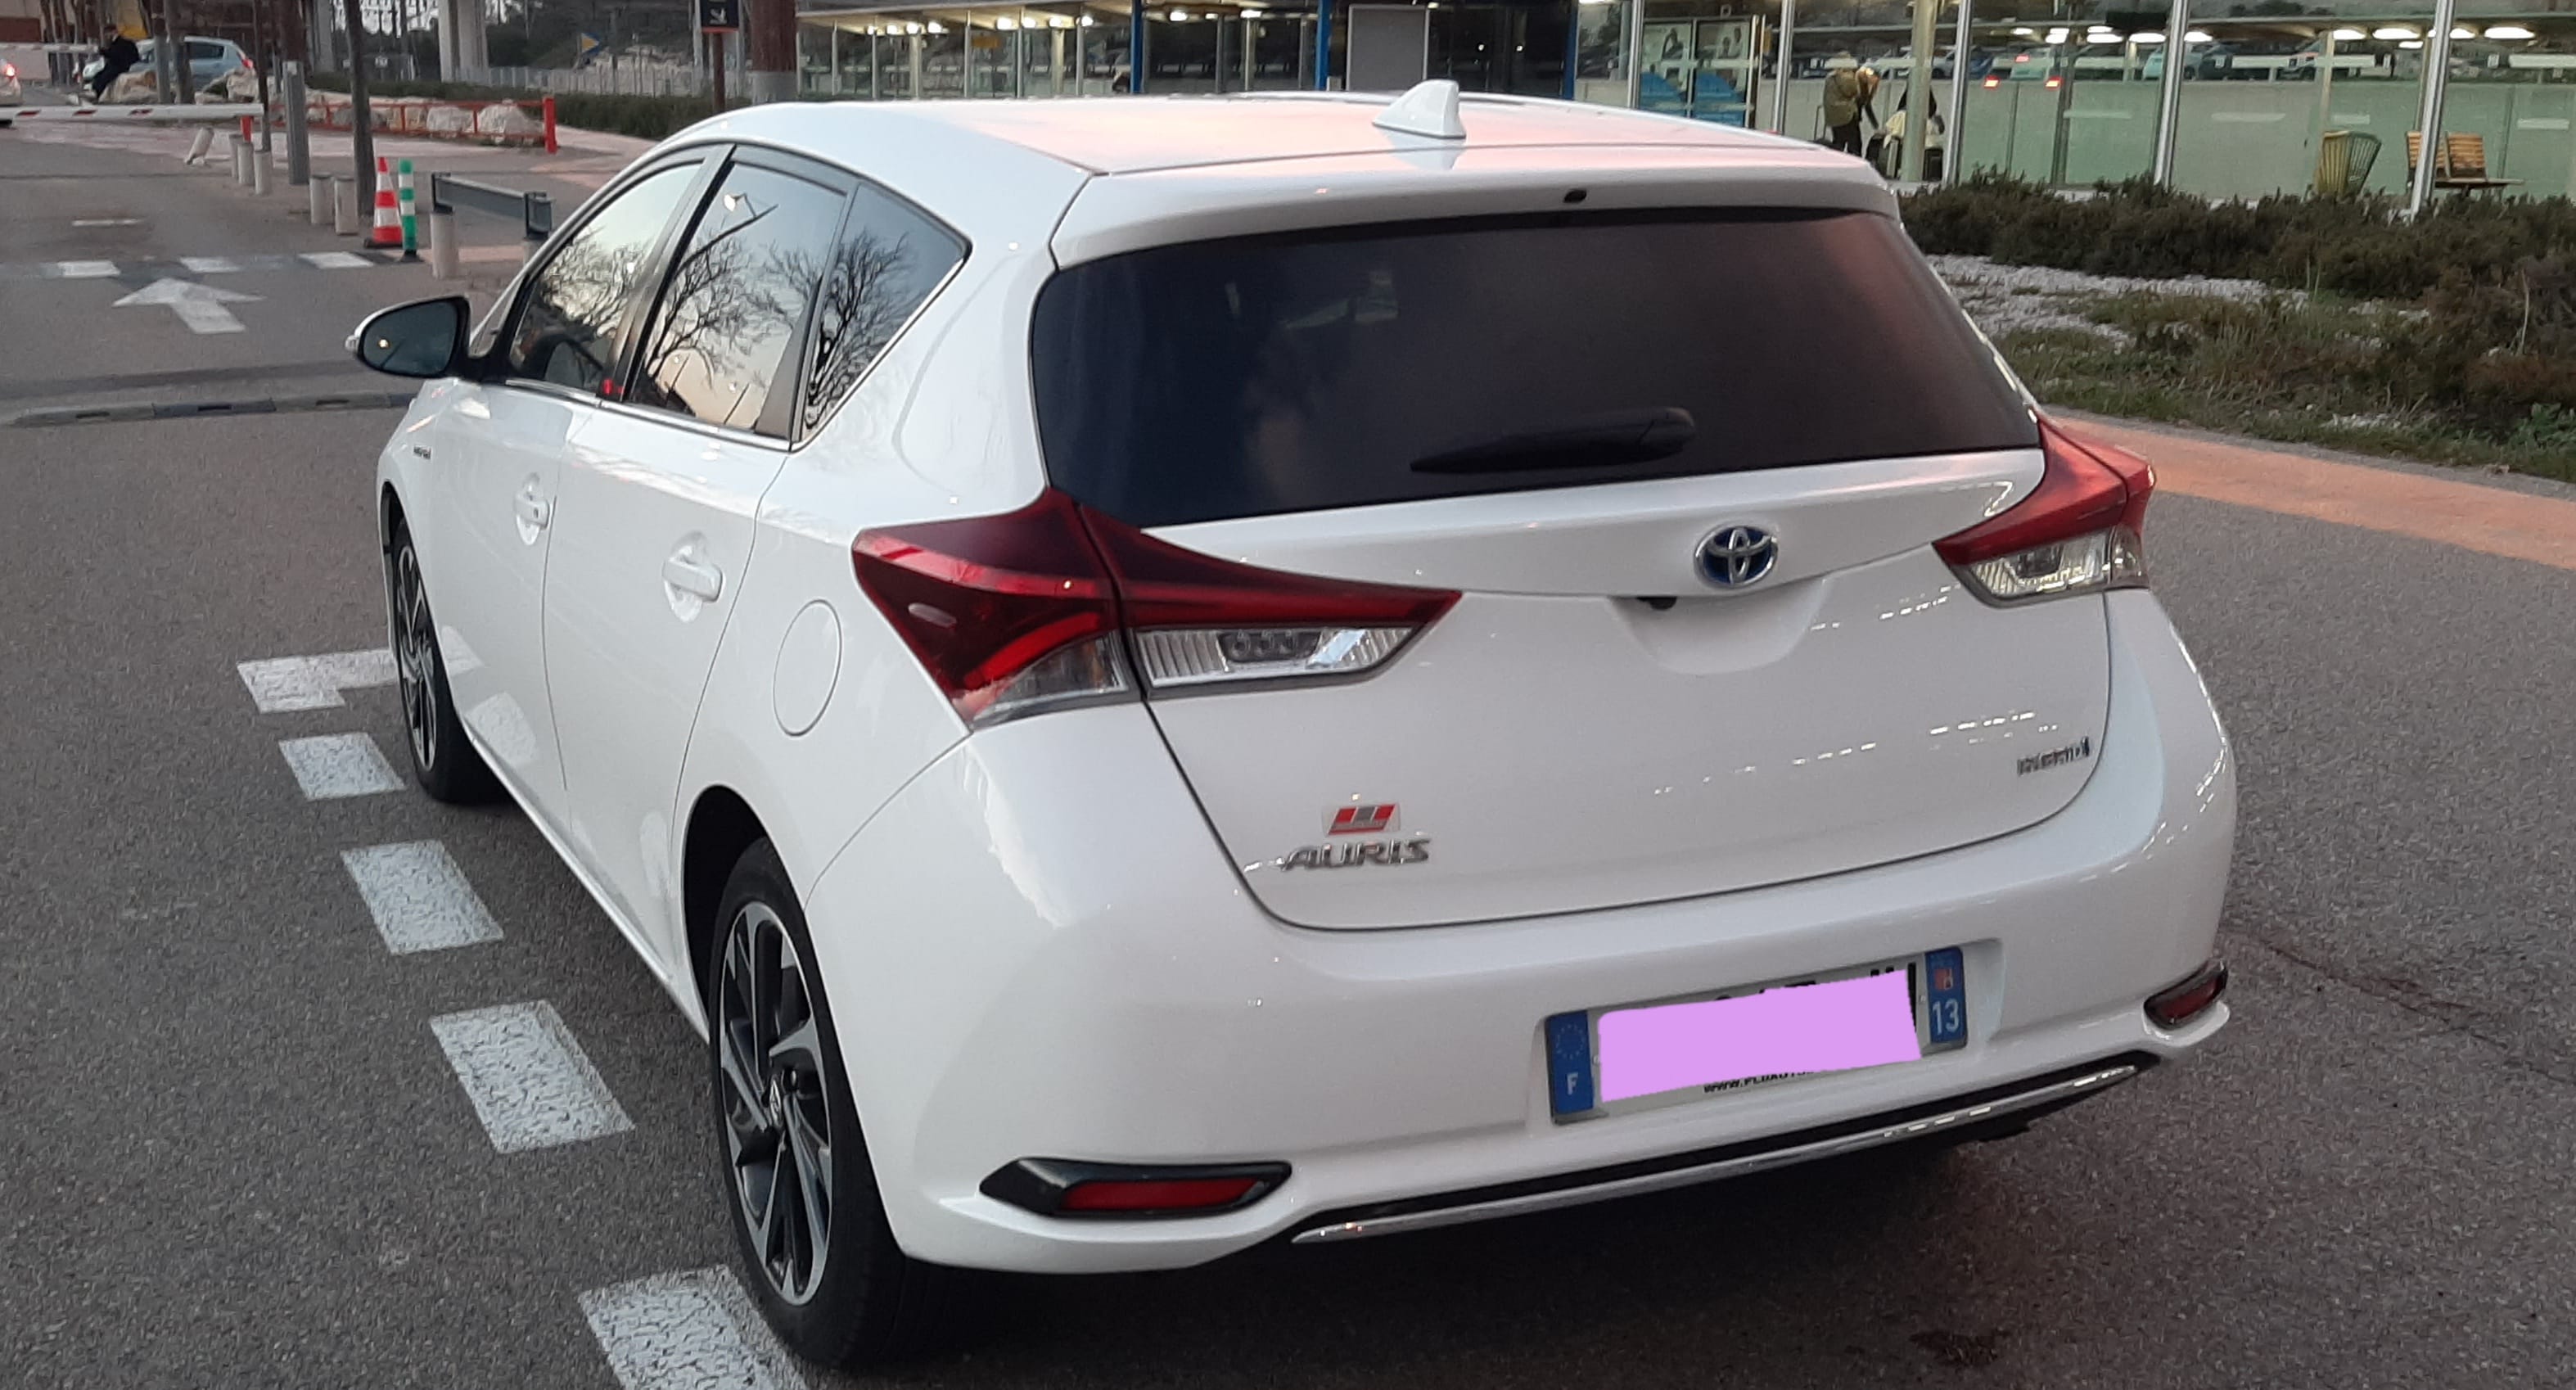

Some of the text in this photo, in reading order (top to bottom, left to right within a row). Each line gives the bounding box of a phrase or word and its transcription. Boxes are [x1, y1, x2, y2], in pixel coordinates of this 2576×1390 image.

[1281, 837, 1431, 871] AURIS
[1933, 998, 1960, 1035] 13
[1567, 1072, 1579, 1095] F
